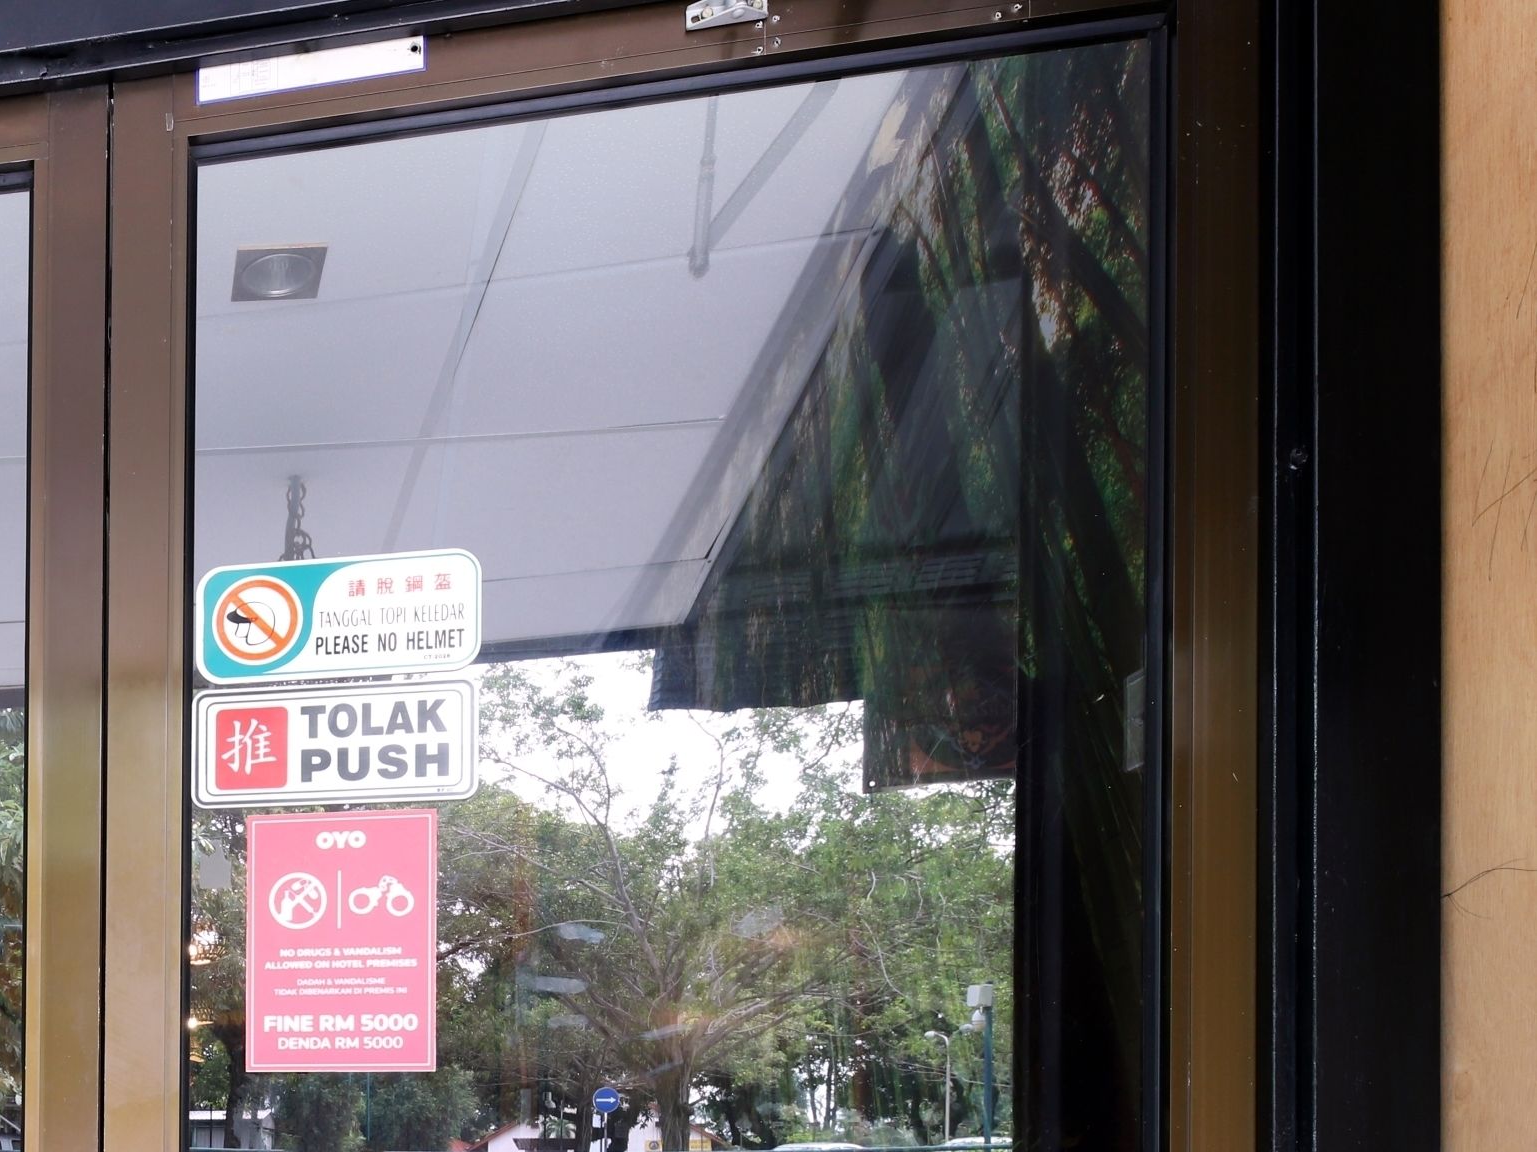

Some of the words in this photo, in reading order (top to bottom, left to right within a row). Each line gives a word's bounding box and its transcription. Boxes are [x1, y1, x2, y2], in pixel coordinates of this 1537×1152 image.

[318, 609, 373, 629] TANGGAL
[380, 606, 407, 625] TOPI
[414, 602, 466, 623] KELEDAR
[314, 633, 370, 656] PLEASE
[377, 631, 398, 652] NO
[406, 627, 466, 651] HELMET
[300, 698, 448, 740] TOLAK
[221, 717, 278, 776] 推
[300, 742, 450, 783] PUSH
[315, 830, 366, 849] OYO
[279, 948, 295, 958] NO
[296, 947, 332, 958] DRUGS
[342, 945, 403, 956] VANDALISM
[264, 961, 313, 970] ALLOWED
[314, 960, 331, 969] ON
[332, 959, 364, 969] HOTEL
[366, 958, 418, 968] PREMISES
[263, 1014, 314, 1033] FINE
[319, 1013, 355, 1032] RM
[360, 1012, 419, 1031] 5000
[277, 1036, 331, 1050] DENDA
[334, 1036, 360, 1049] RM
[363, 1035, 404, 1049] 5000
